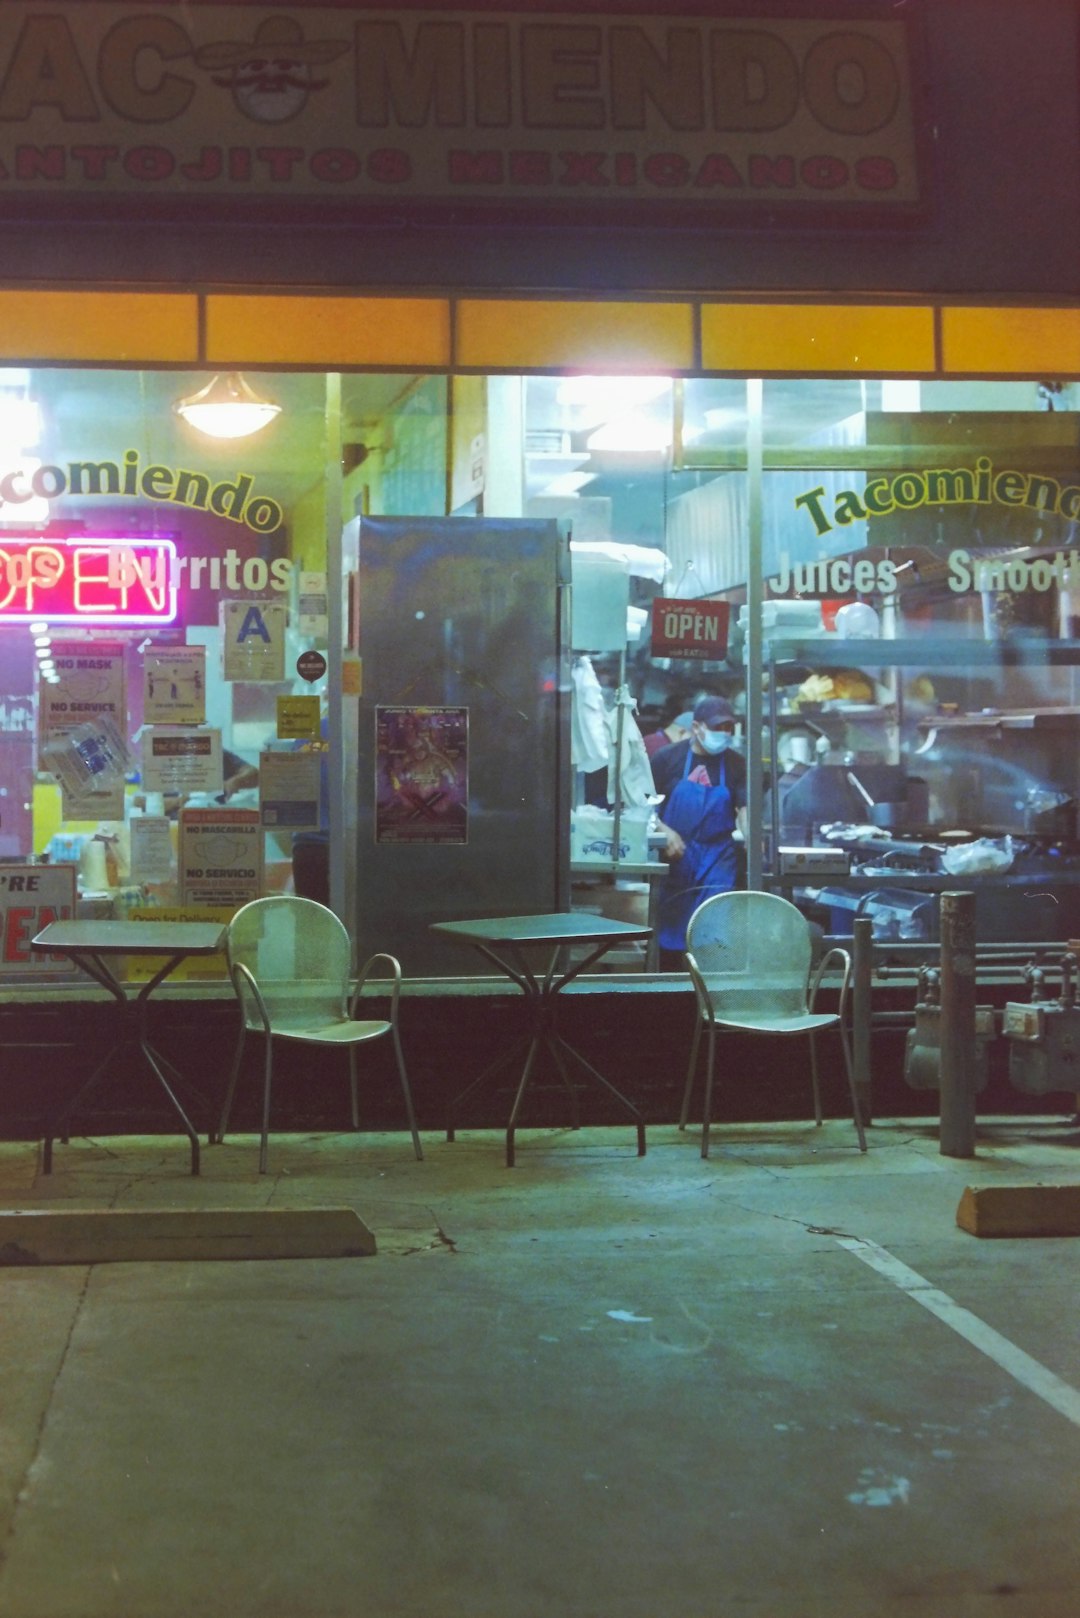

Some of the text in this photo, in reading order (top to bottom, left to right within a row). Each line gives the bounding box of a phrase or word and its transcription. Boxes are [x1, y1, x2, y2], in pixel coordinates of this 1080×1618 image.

[354, 18, 899, 136] MIENDO
[0, 144, 900, 191] NTOJITOS MEXICANOS
[0, 449, 283, 534] comiendo
[107, 546, 292, 591] Burritos
[769, 553, 897, 593] Juices
[236, 606, 271, 643] A
[664, 612, 719, 641] OPEN
[56, 659, 112, 670] NO MASK
[51, 702, 116, 712] NO SERVICE
[186, 826, 256, 835] NO MASCARILLA
[186, 868, 256, 879] NO SERVICIO
